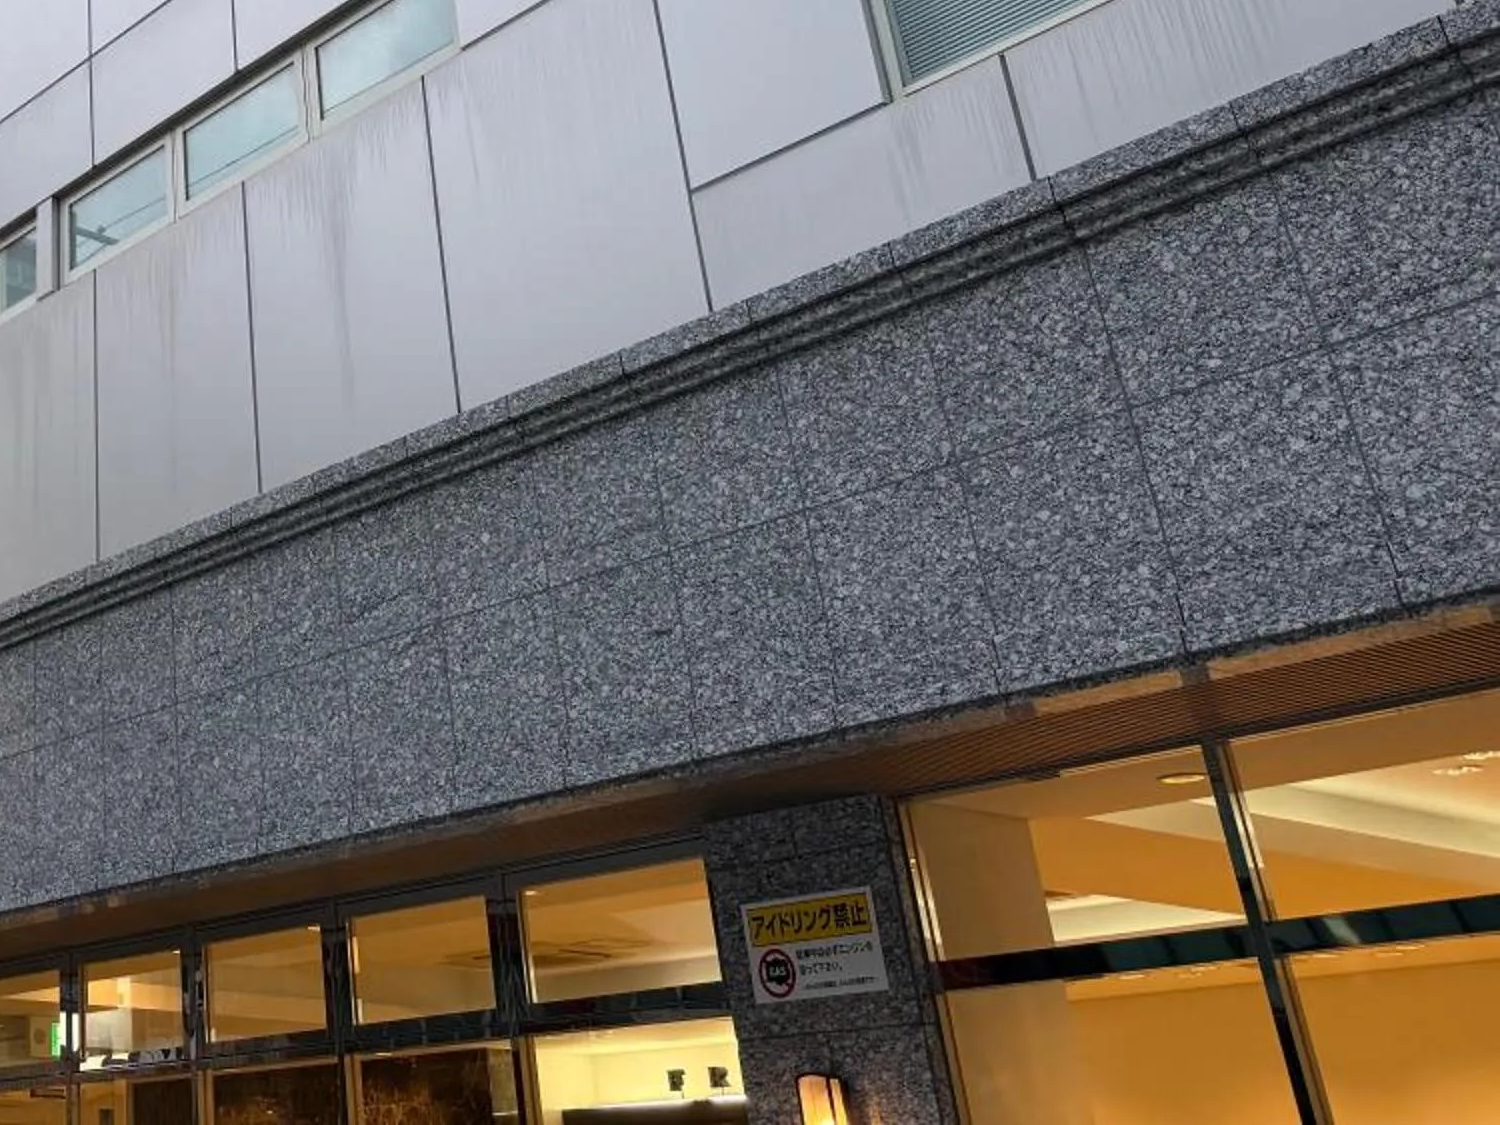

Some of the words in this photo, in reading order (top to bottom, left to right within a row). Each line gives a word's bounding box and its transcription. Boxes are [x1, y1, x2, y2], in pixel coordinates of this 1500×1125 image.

[751, 900, 868, 940] アイドリング禁止
